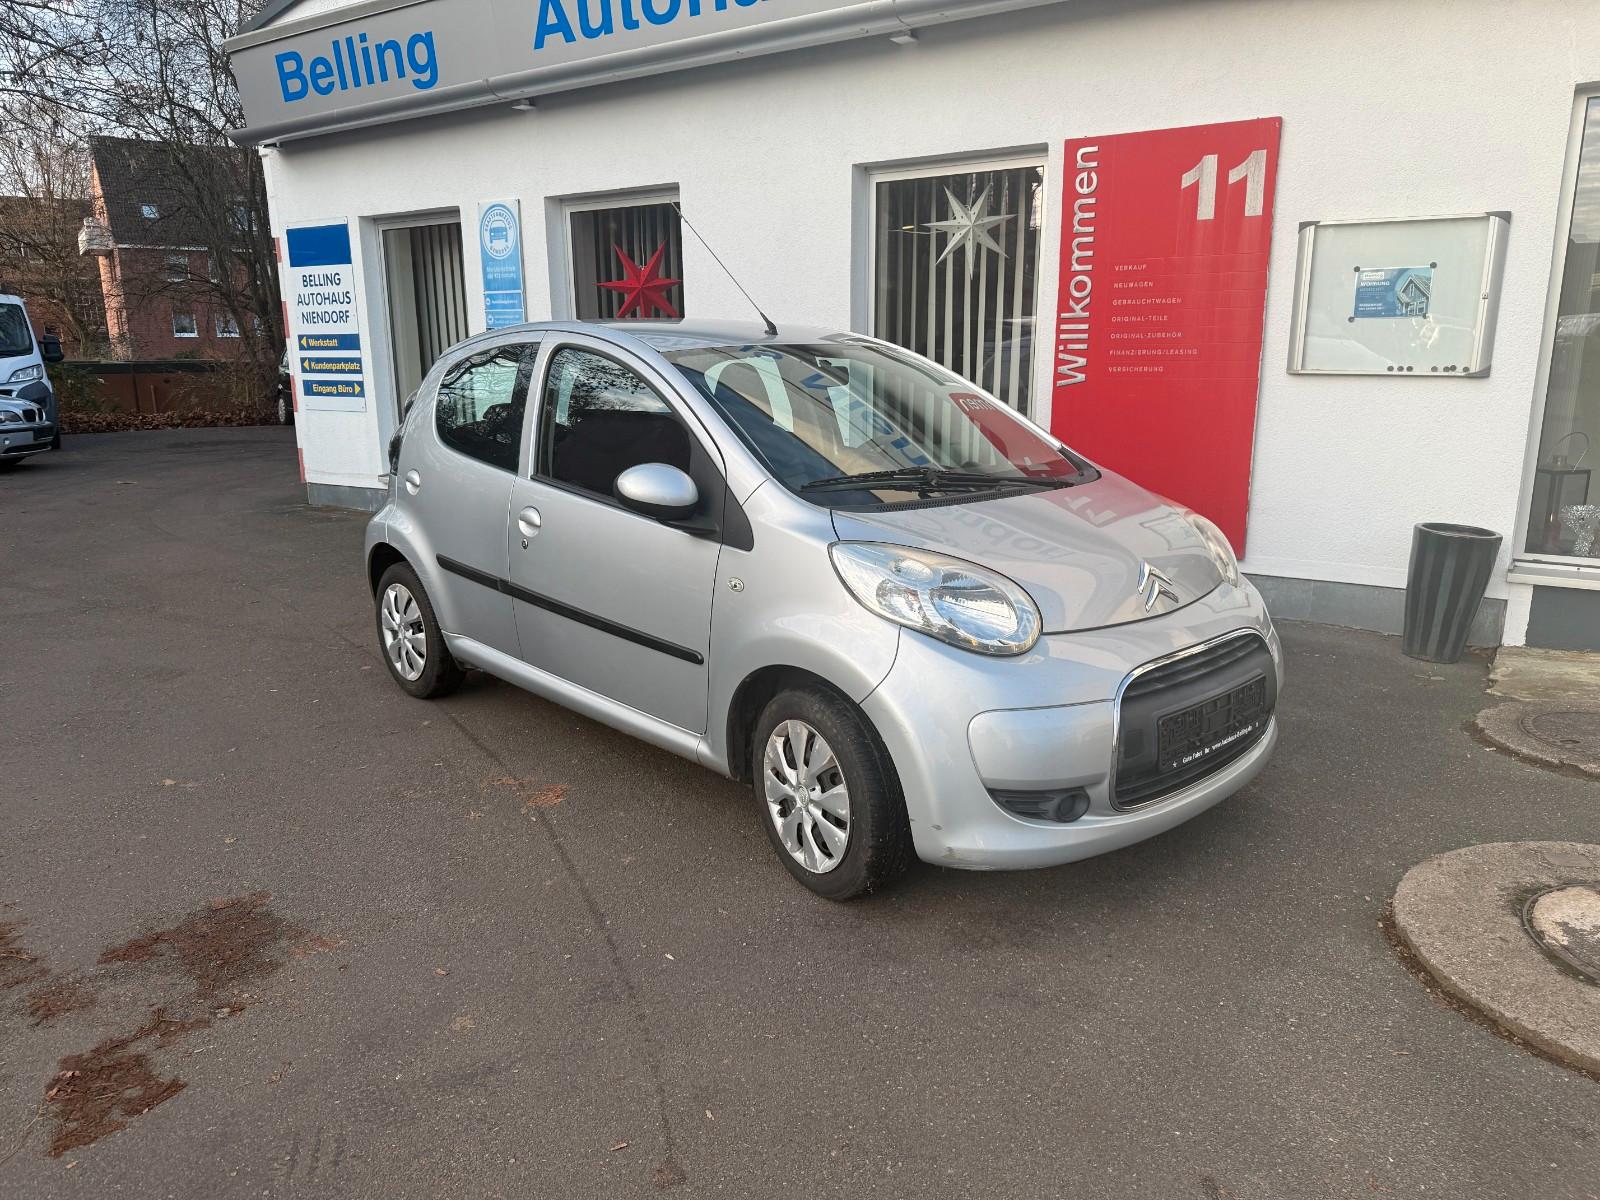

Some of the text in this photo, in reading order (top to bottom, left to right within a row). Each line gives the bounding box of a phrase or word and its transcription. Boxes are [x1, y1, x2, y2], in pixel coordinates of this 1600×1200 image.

[274, 31, 439, 103] Belling
[1181, 149, 1267, 221] 11
[1056, 145, 1099, 387] Willkommen
[1114, 264, 1148, 272] VERKAUF
[302, 272, 341, 288] BELLING
[1113, 281, 1154, 289] NEUWAGEN
[297, 291, 351, 306] AUTOHAUS
[1112, 297, 1182, 306] GEBRAUCHTWAGEN
[301, 310, 350, 325] NIENDORF
[1111, 315, 1168, 323] ORIGINAL-TEILE
[1110, 331, 1182, 340] ORIGINAL-ZUBEHÖR
[308, 338, 339, 347] Werkstatt
[1109, 348, 1198, 357] FINANZIERUNG/LEASING
[311, 360, 361, 372] Kundenparkplatz
[1108, 366, 1164, 374] VERSICHERUNG
[312, 383, 353, 394] Eingang Büro
